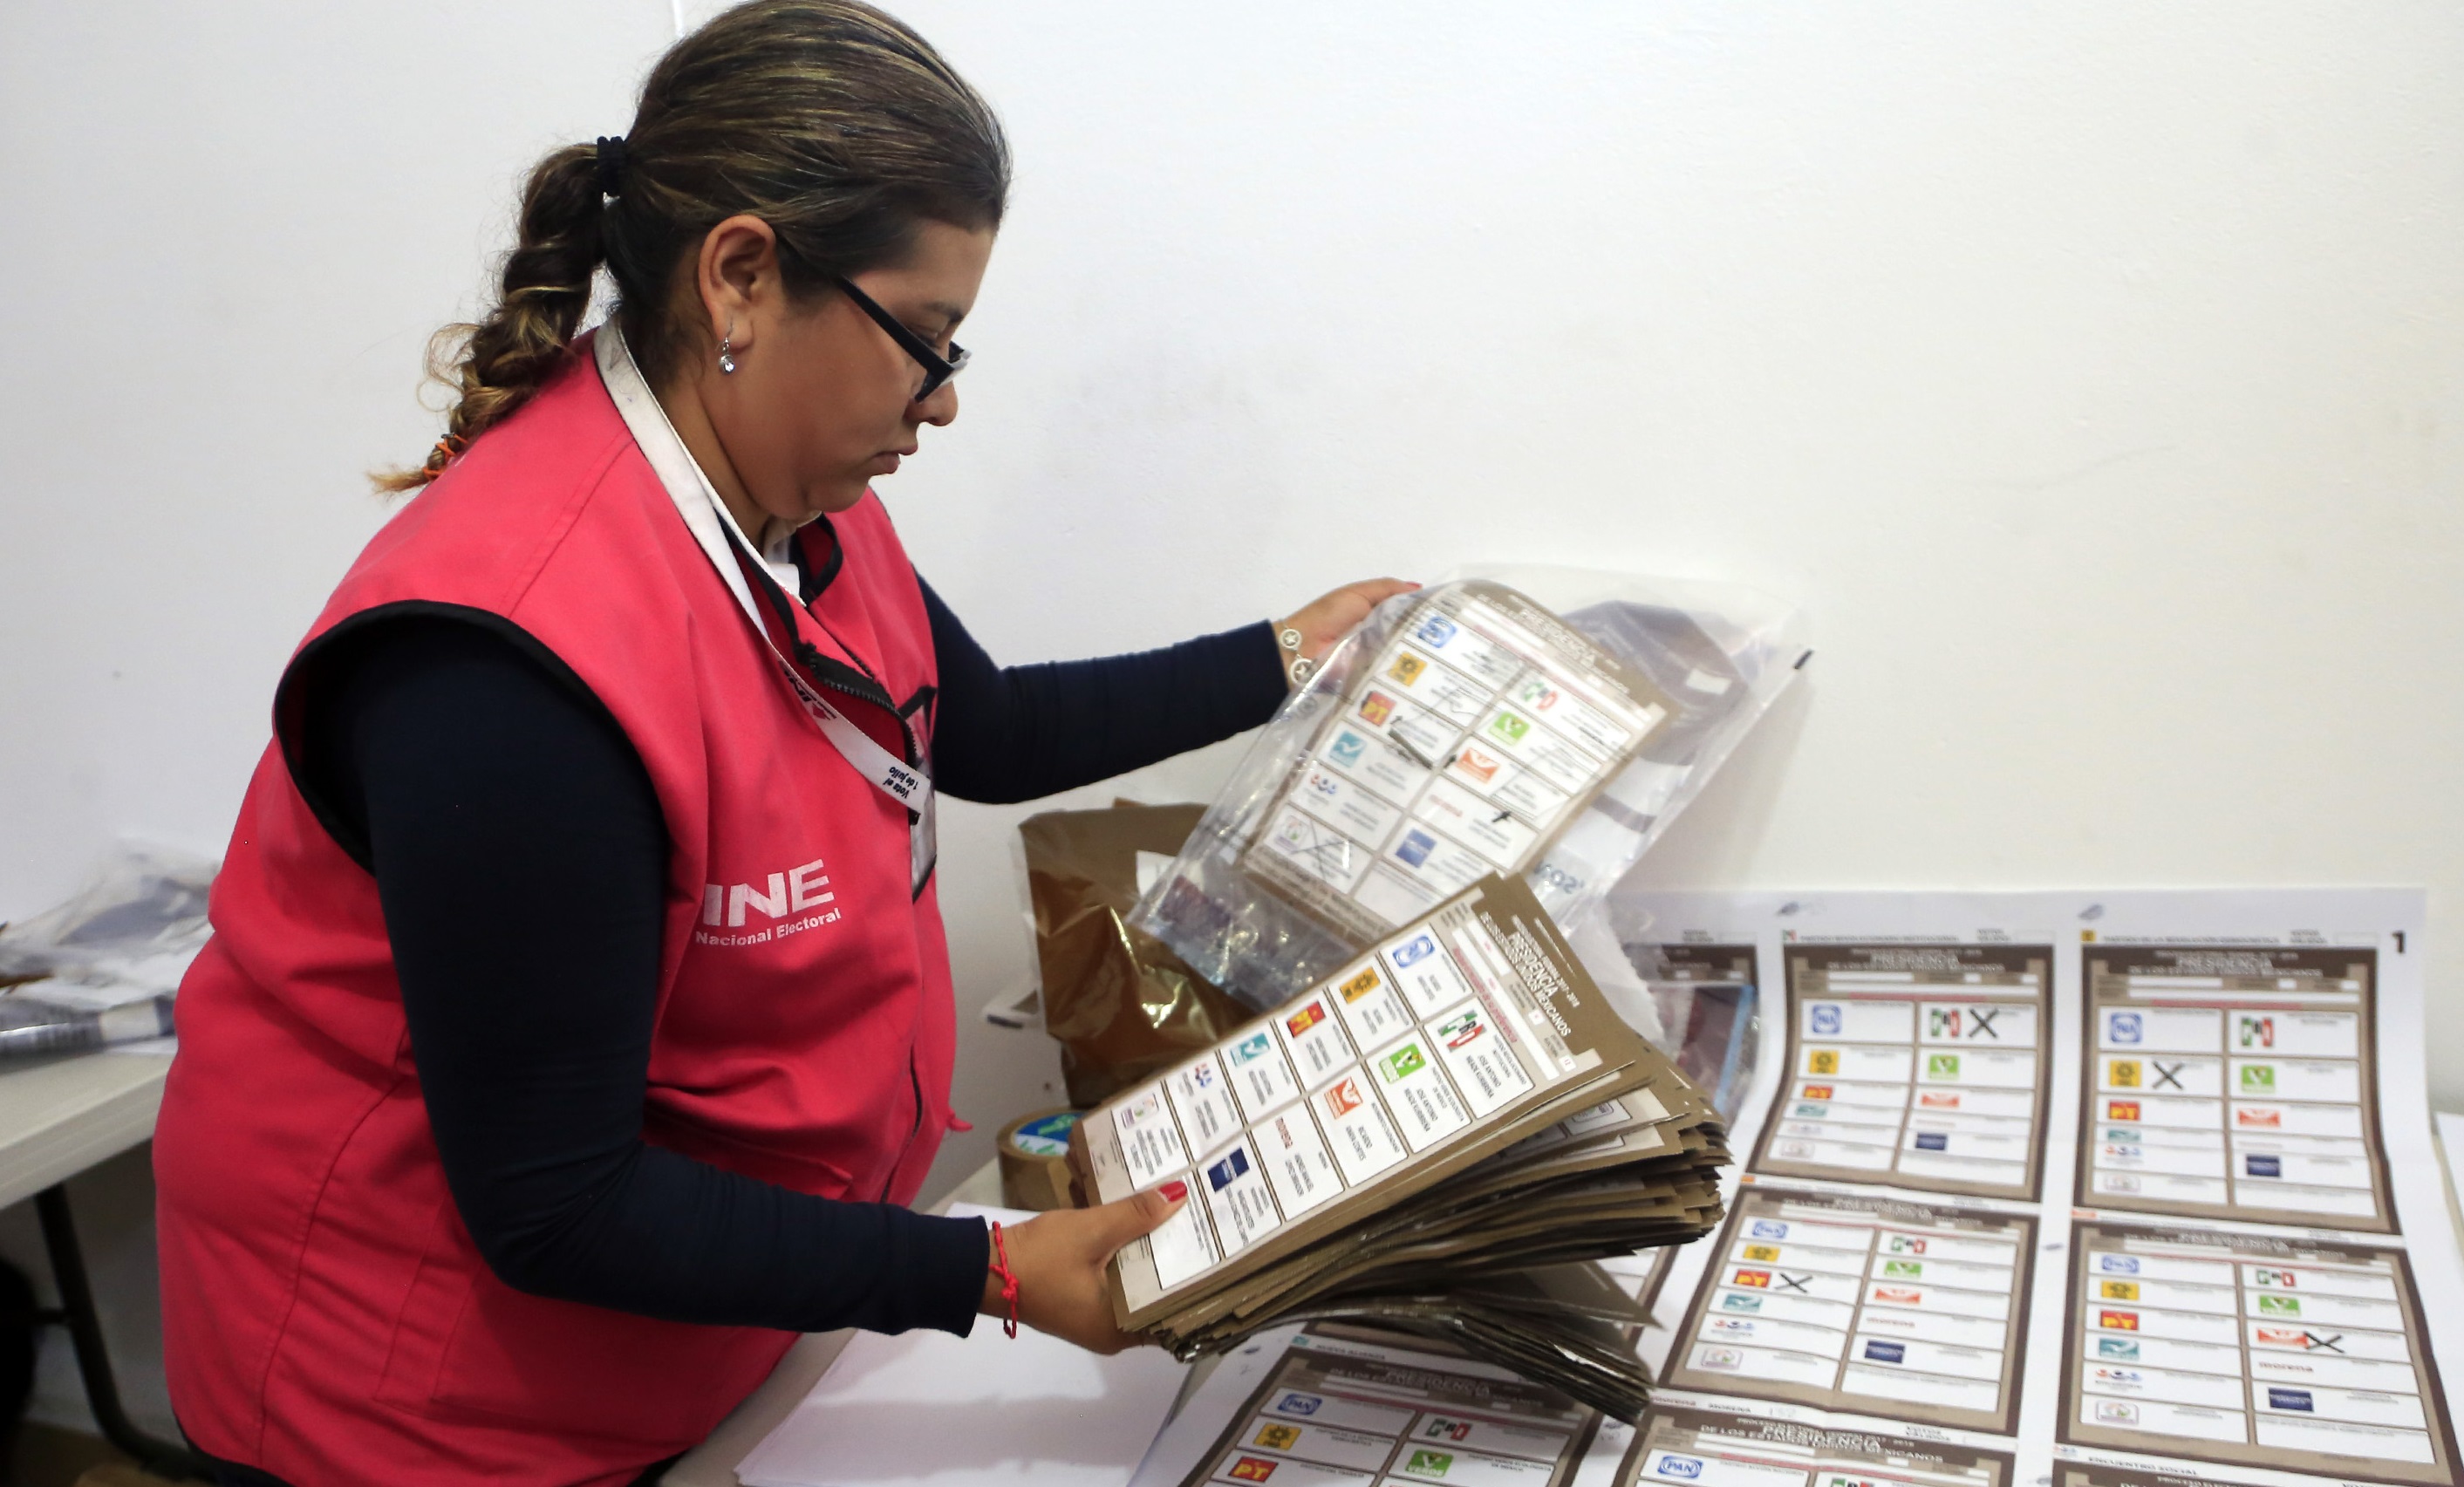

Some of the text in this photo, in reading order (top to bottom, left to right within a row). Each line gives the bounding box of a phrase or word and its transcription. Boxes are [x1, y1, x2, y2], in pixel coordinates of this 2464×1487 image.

[884, 777, 910, 798] Vota el
[889, 766, 919, 790] 1 de julio
[703, 859, 834, 926] INE
[695, 907, 842, 946] Nacional Electoral
[2392, 930, 2405, 954] 1
[1505, 932, 1558, 997] PRESIDENCIA
[1516, 963, 1541, 992] UNIDOS
[1532, 989, 1571, 1036] MEXICANOS
[1275, 1117, 1293, 1149] morena
[1763, 1424, 1880, 1454] PRESIDENCIA
[1233, 1463, 1269, 1480] PT
[1667, 1462, 1694, 1473] PAN
